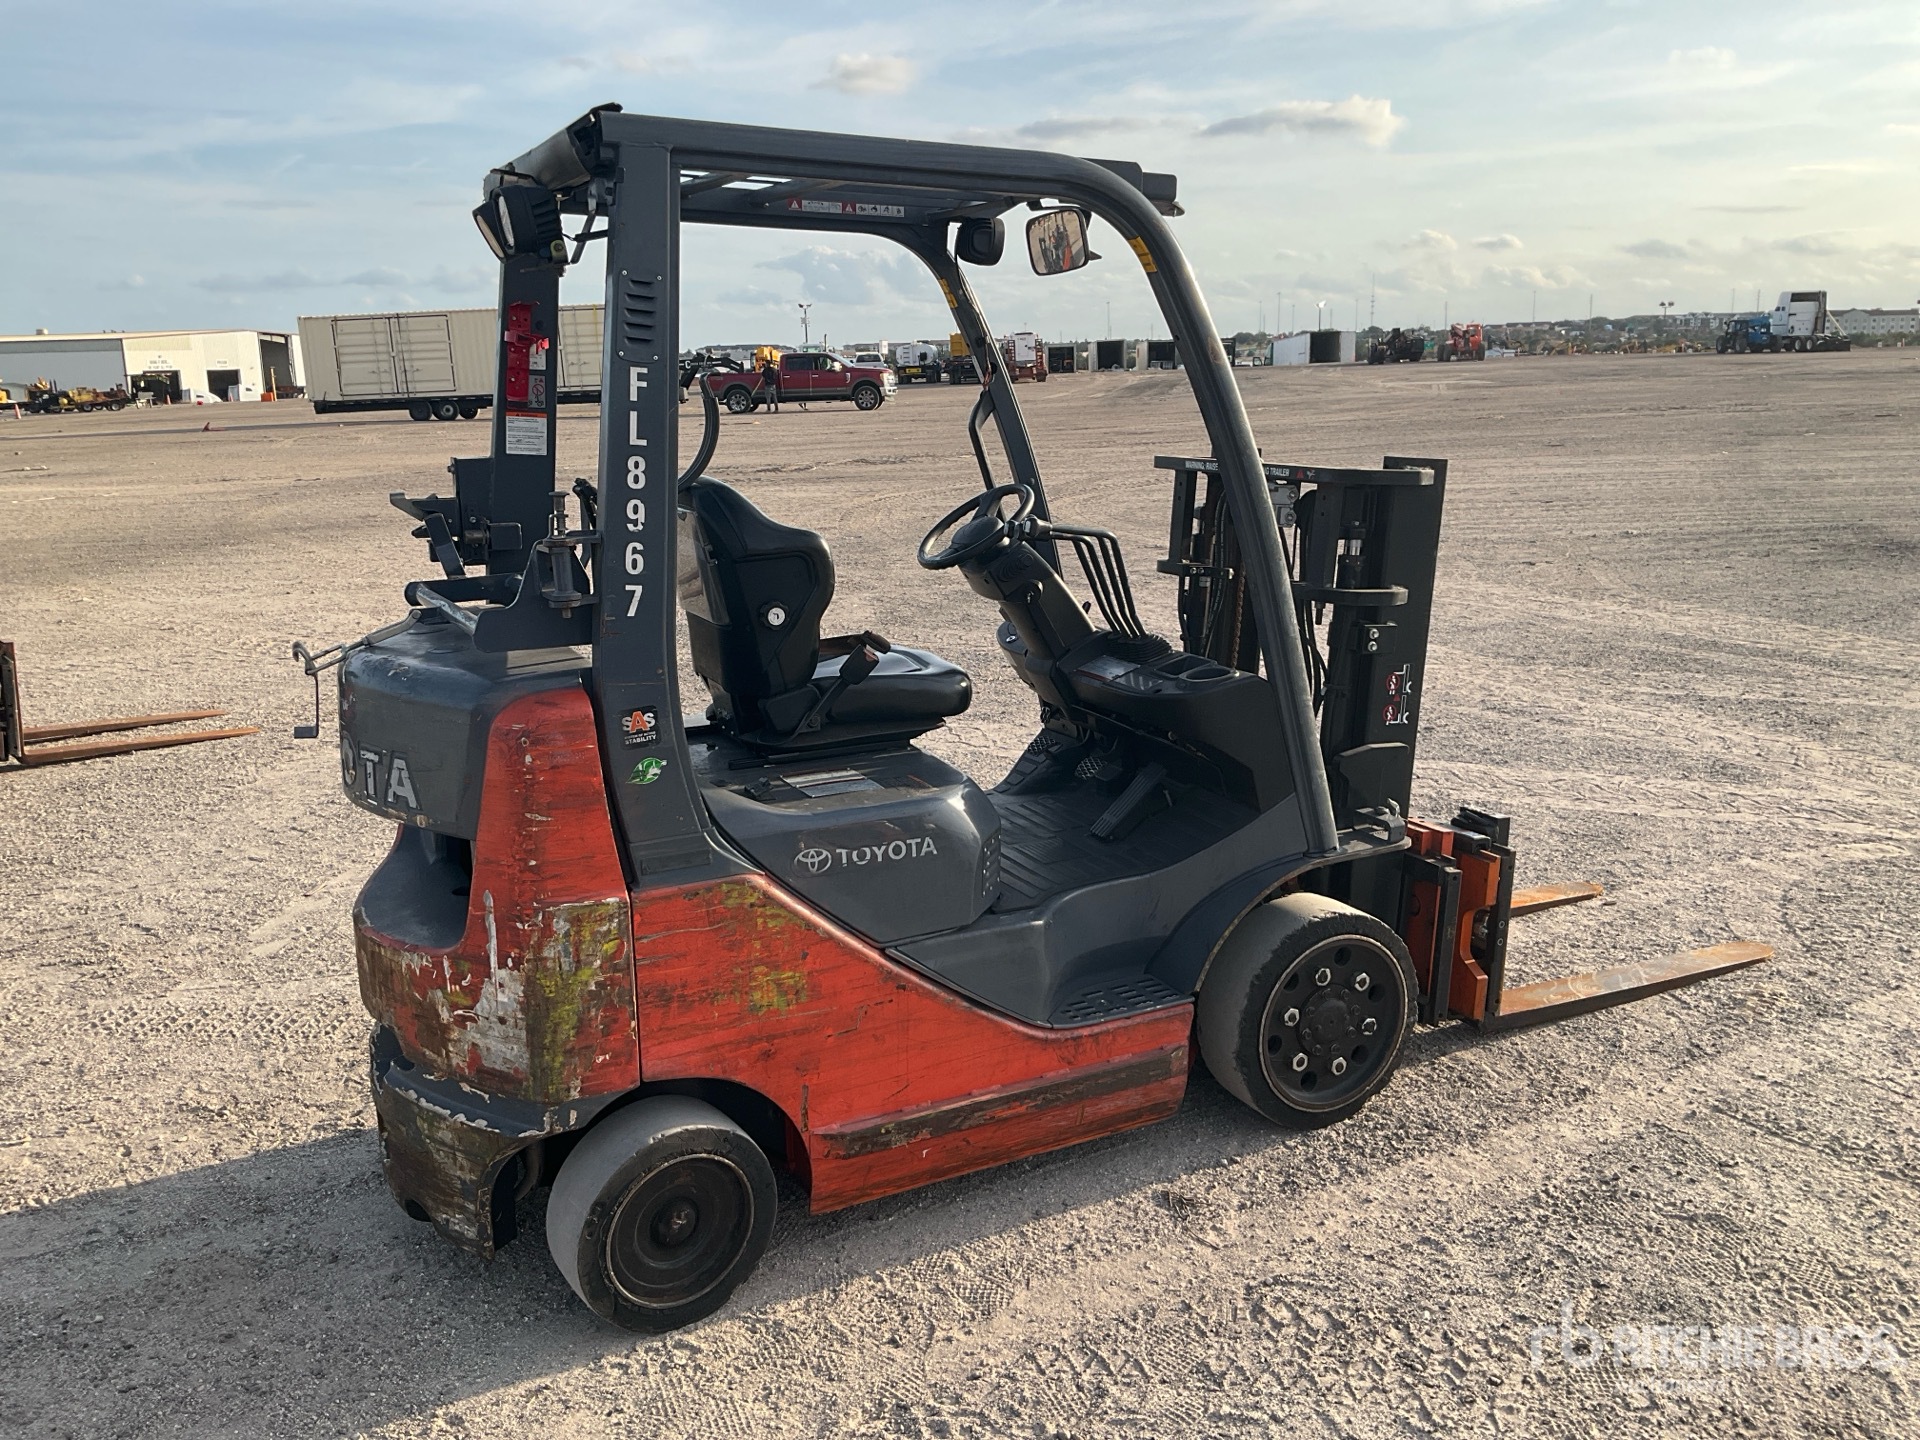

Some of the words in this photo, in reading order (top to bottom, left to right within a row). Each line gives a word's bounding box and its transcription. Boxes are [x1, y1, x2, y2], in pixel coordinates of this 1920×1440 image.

[1270, 467, 1289, 477] TRAILER
[625, 366, 649, 617] FL8967
[622, 711, 655, 733] SAS
[625, 735, 656, 745] STABILITY
[836, 836, 938, 867] TOYOTA
